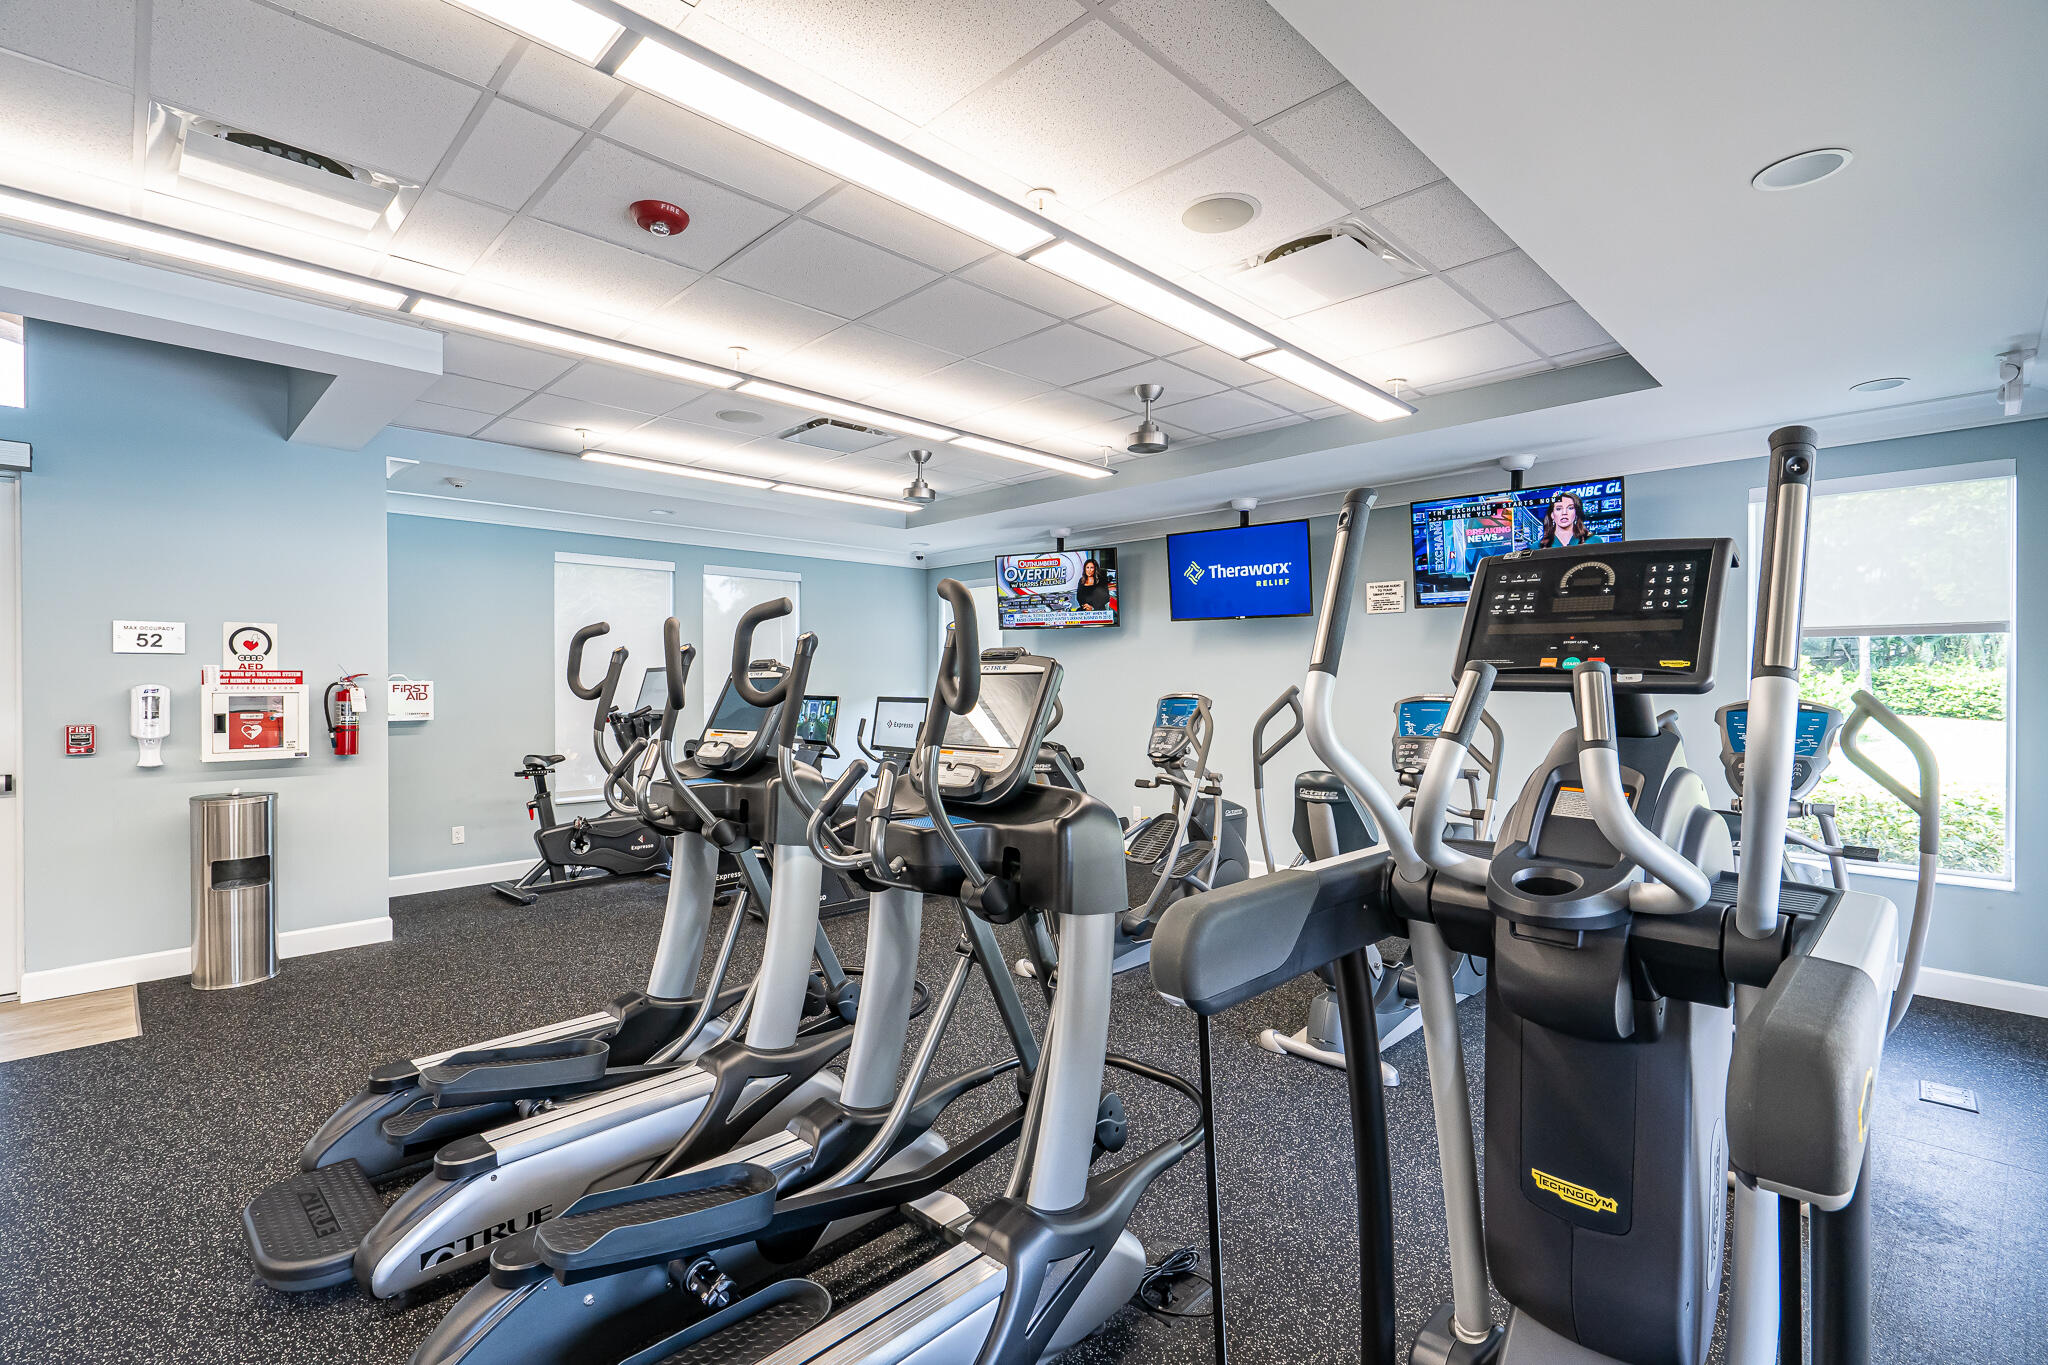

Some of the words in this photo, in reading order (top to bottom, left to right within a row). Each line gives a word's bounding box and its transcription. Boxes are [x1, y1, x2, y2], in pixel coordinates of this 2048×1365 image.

[660, 203, 680, 215] FIRE
[1502, 500, 1534, 508] STARTS
[1465, 526, 1511, 536] BREAKING
[1467, 534, 1498, 543] NEWS
[1434, 521, 1445, 571] EXCHANG
[1004, 566, 1067, 582] OVERTIME
[1256, 578, 1290, 587] RELIEF
[1681, 587, 1688, 595] 9
[1662, 600, 1669, 608] 0
[136, 633, 163, 647] 52
[405, 692, 428, 701] AID
[893, 721, 914, 729] Expresso
[1299, 788, 1338, 797] Octane
[630, 843, 654, 851] Expresso
[715, 871, 743, 881] Express
[464, 1203, 553, 1255] TRUE
